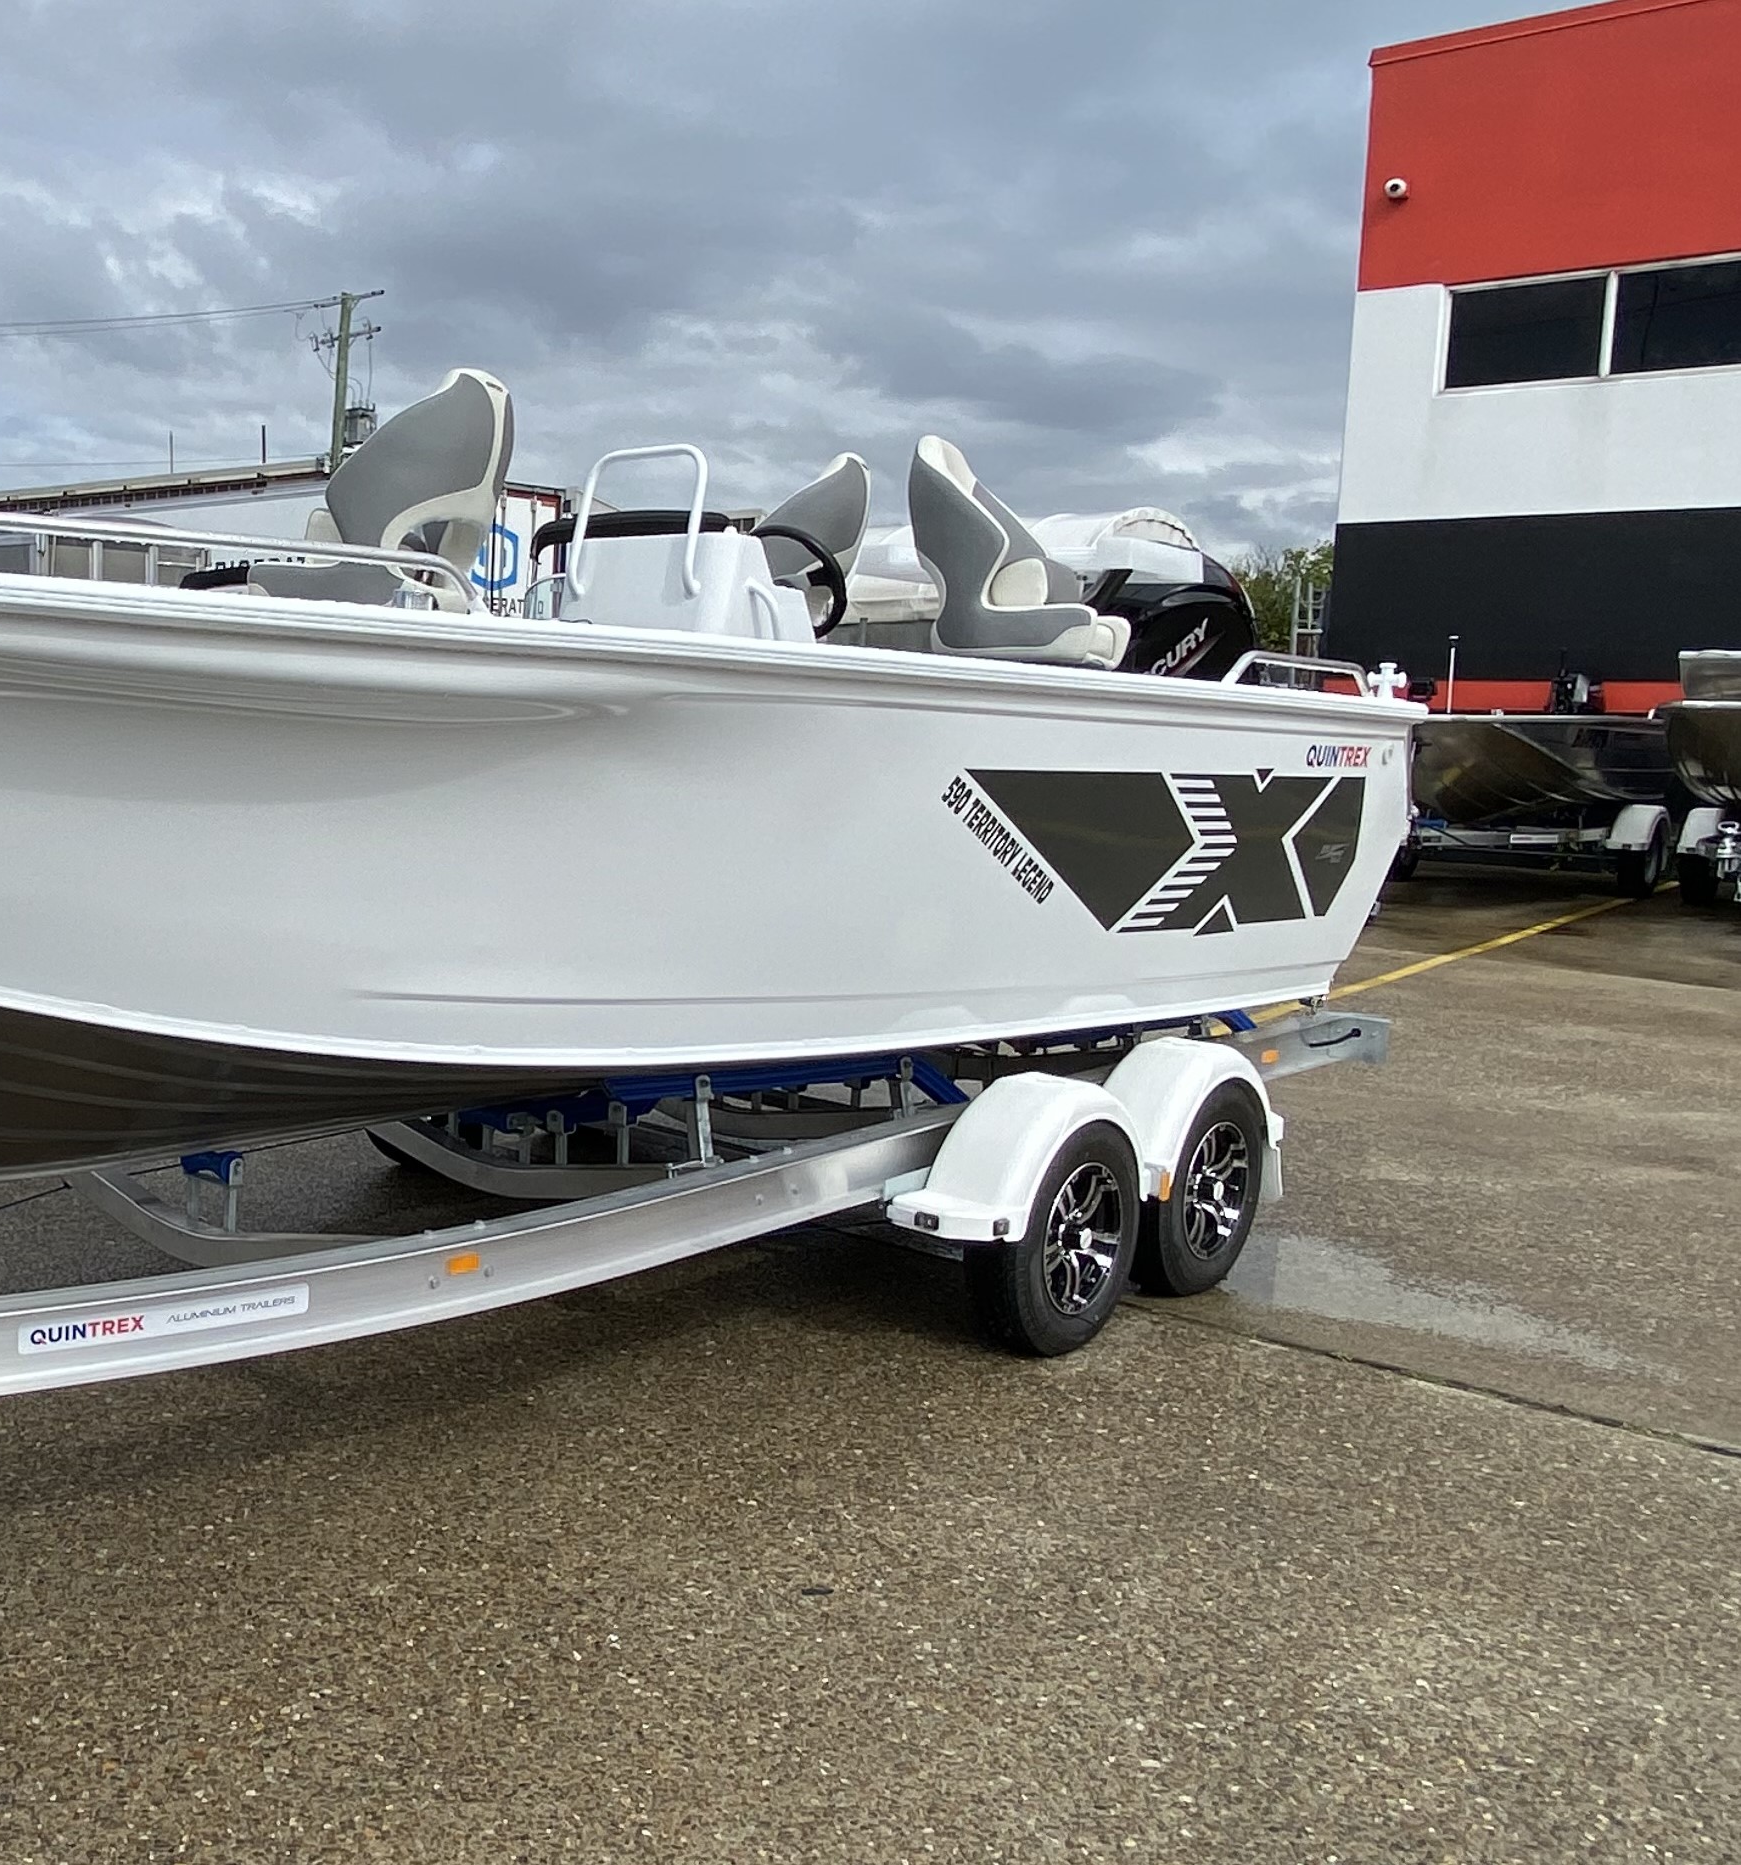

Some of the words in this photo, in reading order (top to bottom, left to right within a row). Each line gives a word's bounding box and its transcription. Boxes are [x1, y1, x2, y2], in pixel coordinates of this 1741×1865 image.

[1143, 617, 1209, 675] CURY
[1306, 744, 1372, 768] QUINTREX
[941, 775, 973, 815] 590
[962, 797, 1023, 868] TERRITORY
[1011, 851, 1054, 904] LEGEND
[30, 1315, 145, 1345] QUINTREX
[166, 1305, 237, 1324] ALUMINIUM
[241, 1295, 296, 1312] TRAILERS
